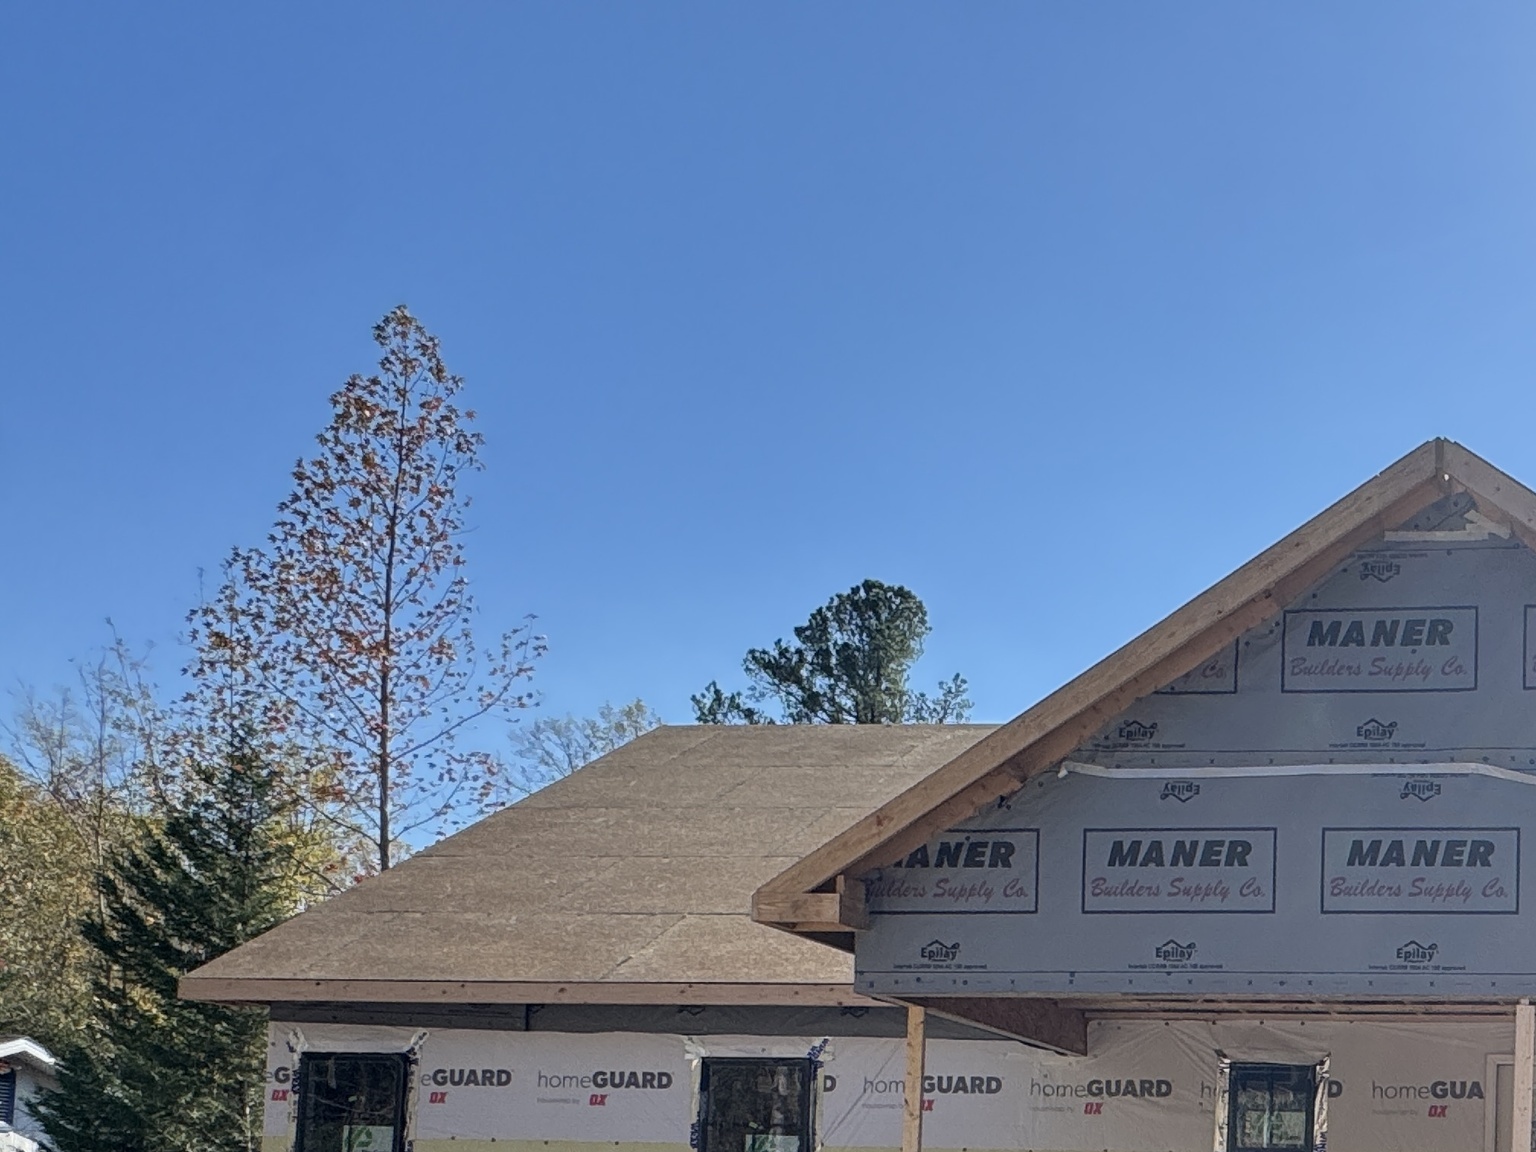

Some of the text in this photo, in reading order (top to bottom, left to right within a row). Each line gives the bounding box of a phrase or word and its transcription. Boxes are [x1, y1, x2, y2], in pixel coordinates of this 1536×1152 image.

[1306, 618, 1454, 647] MANER
[1290, 656, 1468, 682] Builders Supply Co.
[1118, 726, 1155, 741] Epilay
[1357, 725, 1395, 740] Epilay
[1162, 782, 1201, 796] Epilay
[1403, 781, 1441, 795] Epilay
[892, 841, 1015, 869] ANER
[1107, 840, 1252, 867] MANER
[1346, 839, 1496, 867] MANER
[933, 878, 1029, 904] Supply Co.
[1091, 876, 1266, 903] Builders Supply Co.
[1330, 876, 1509, 903] Builders Supply Co.
[920, 946, 958, 961] Epilay
[1156, 946, 1193, 962] Epilay
[1396, 947, 1435, 963] Epilay
[421, 1068, 513, 1087] eGUARD
[537, 1070, 674, 1090] homeGUARD
[864, 1076, 1003, 1095] homGUARD
[271, 1089, 289, 1102] OX
[1030, 1078, 1173, 1098] homeGUARD
[1372, 1081, 1485, 1100] homeGUA
[429, 1092, 447, 1105] OX
[589, 1094, 608, 1107] OX
[1084, 1103, 1104, 1116] OX
[1428, 1105, 1448, 1118] OX
